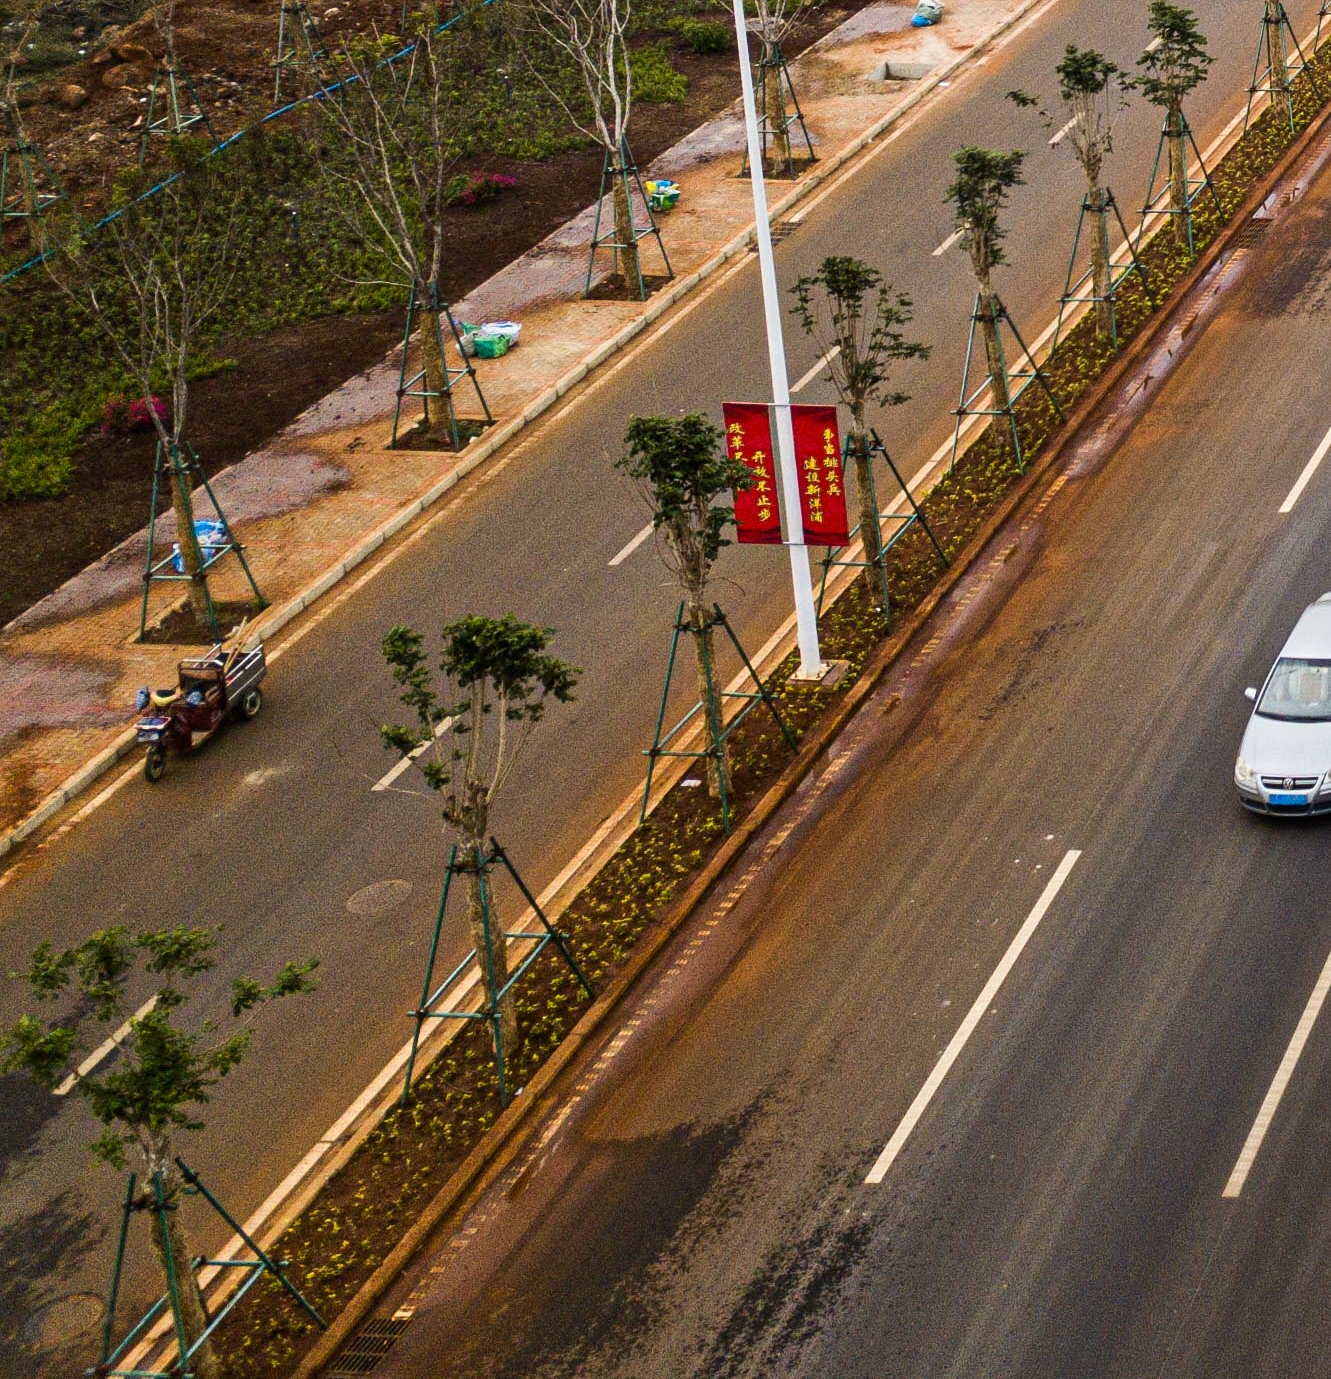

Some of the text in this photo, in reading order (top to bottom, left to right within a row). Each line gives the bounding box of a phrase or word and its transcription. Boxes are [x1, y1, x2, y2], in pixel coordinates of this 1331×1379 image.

[751, 450, 771, 522] 开放不止步
[803, 456, 823, 523] 建设新洋浦
[823, 428, 841, 496] 争当排头兵
